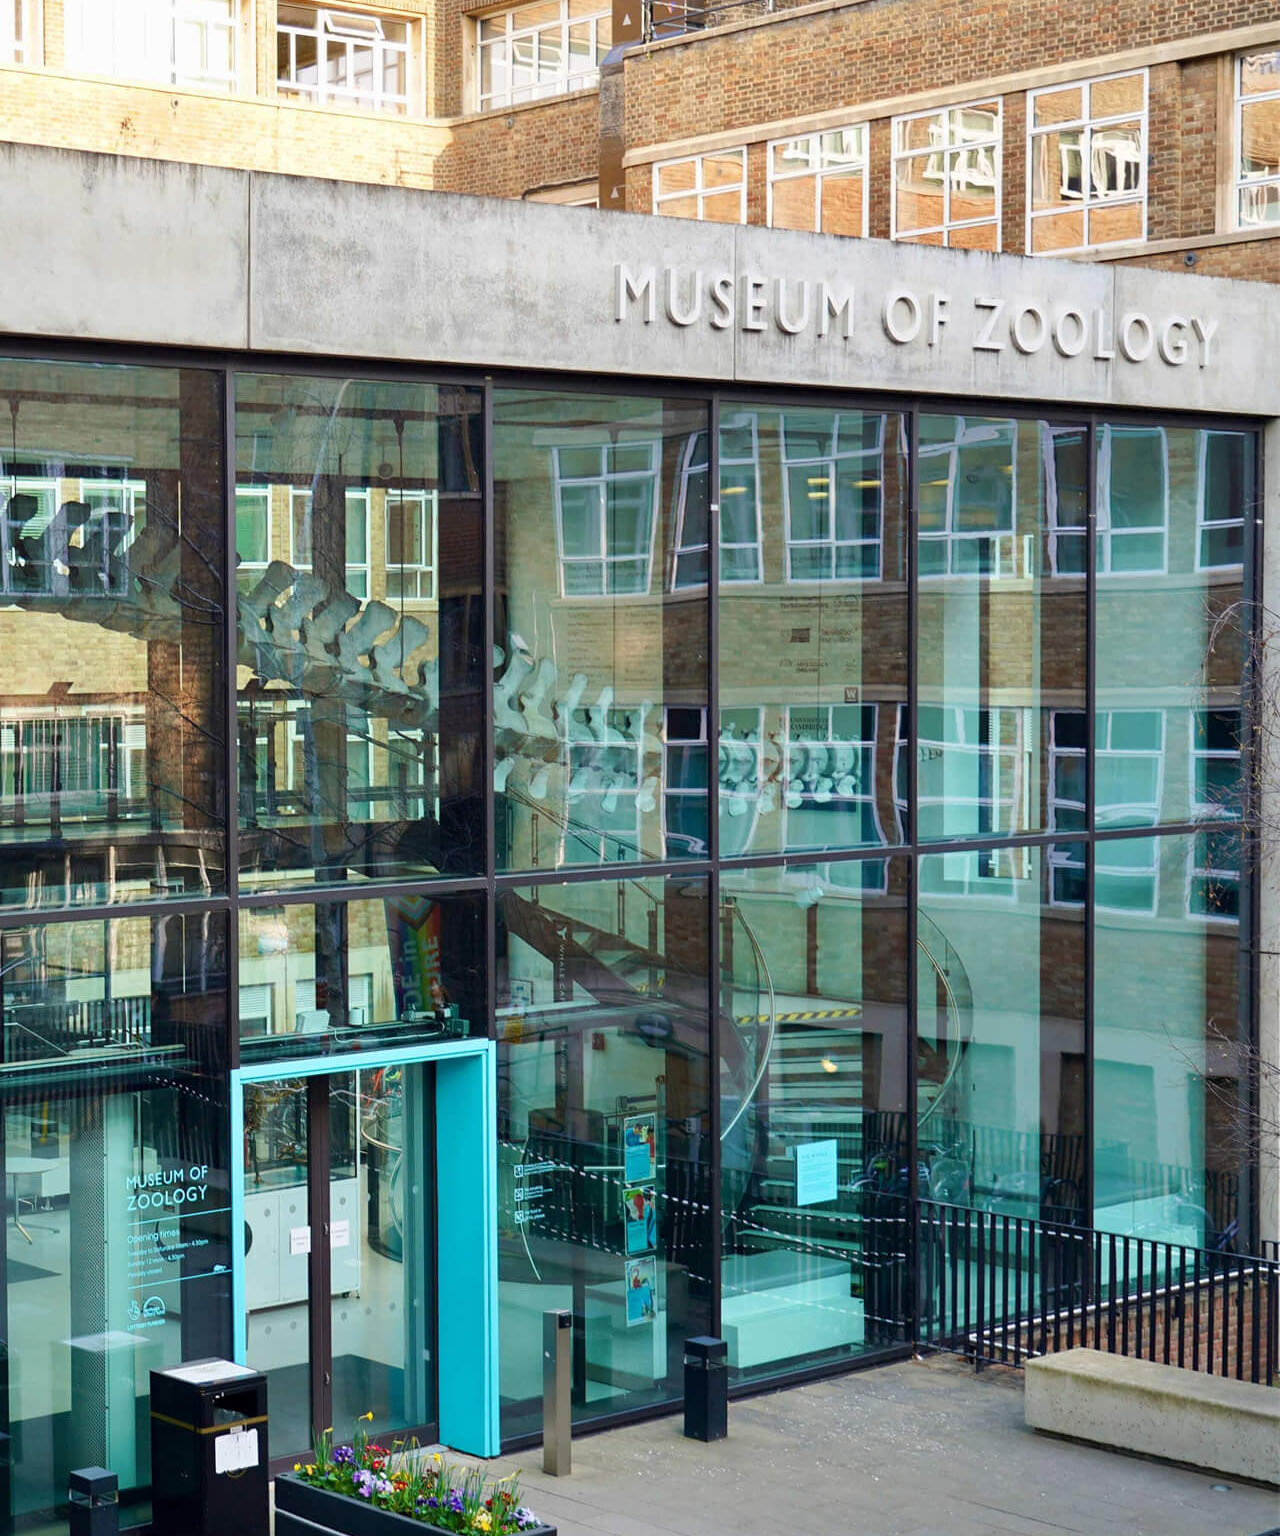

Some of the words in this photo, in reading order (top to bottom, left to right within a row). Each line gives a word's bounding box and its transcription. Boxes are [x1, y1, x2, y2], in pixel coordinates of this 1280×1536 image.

[614, 263, 855, 339] MUSEUM
[883, 290, 951, 347] OF
[972, 297, 1218, 369] ZOOLOGY
[126, 1168, 184, 1190] MUSEUM
[189, 1165, 208, 1181] OF
[127, 1185, 208, 1212] ZOOLOGY
[127, 1231, 159, 1244] Opening
[160, 1229, 180, 1239] times
